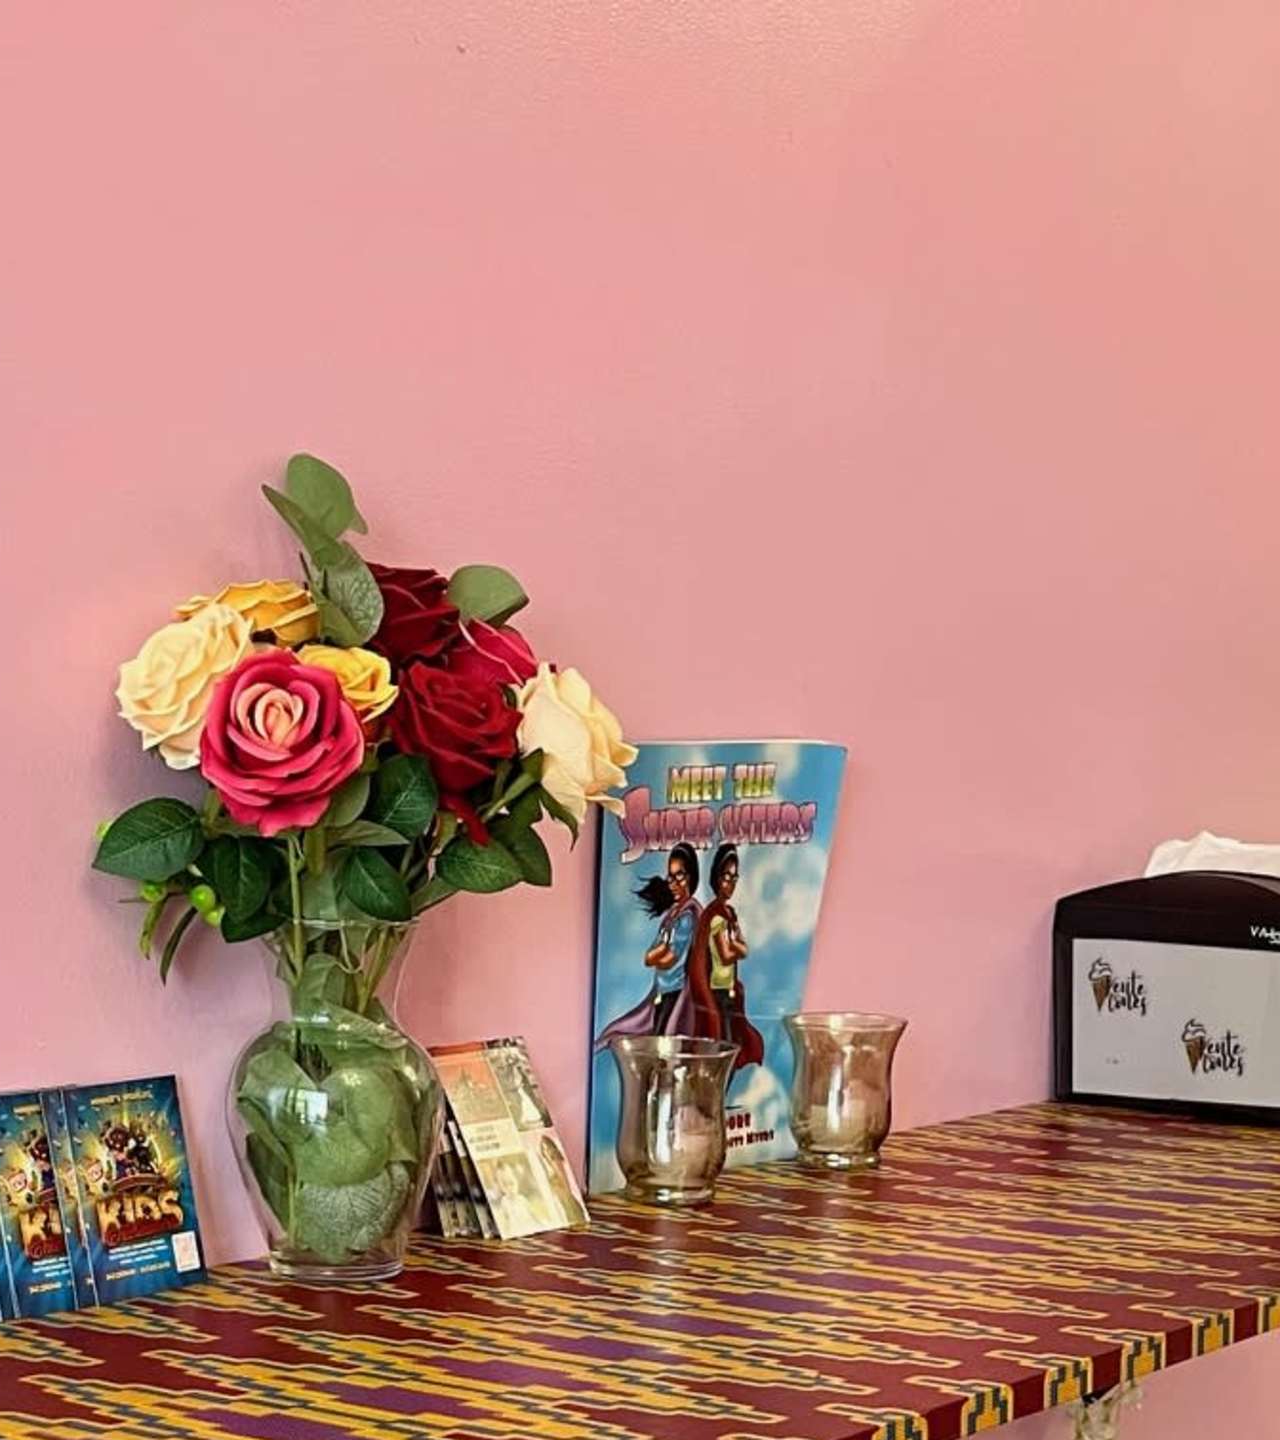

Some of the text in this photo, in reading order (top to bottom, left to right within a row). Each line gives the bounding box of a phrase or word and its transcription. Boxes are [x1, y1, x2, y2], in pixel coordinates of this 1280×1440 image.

[668, 763, 777, 803] MEET THE
[96, 1189, 184, 1244] KIDS
